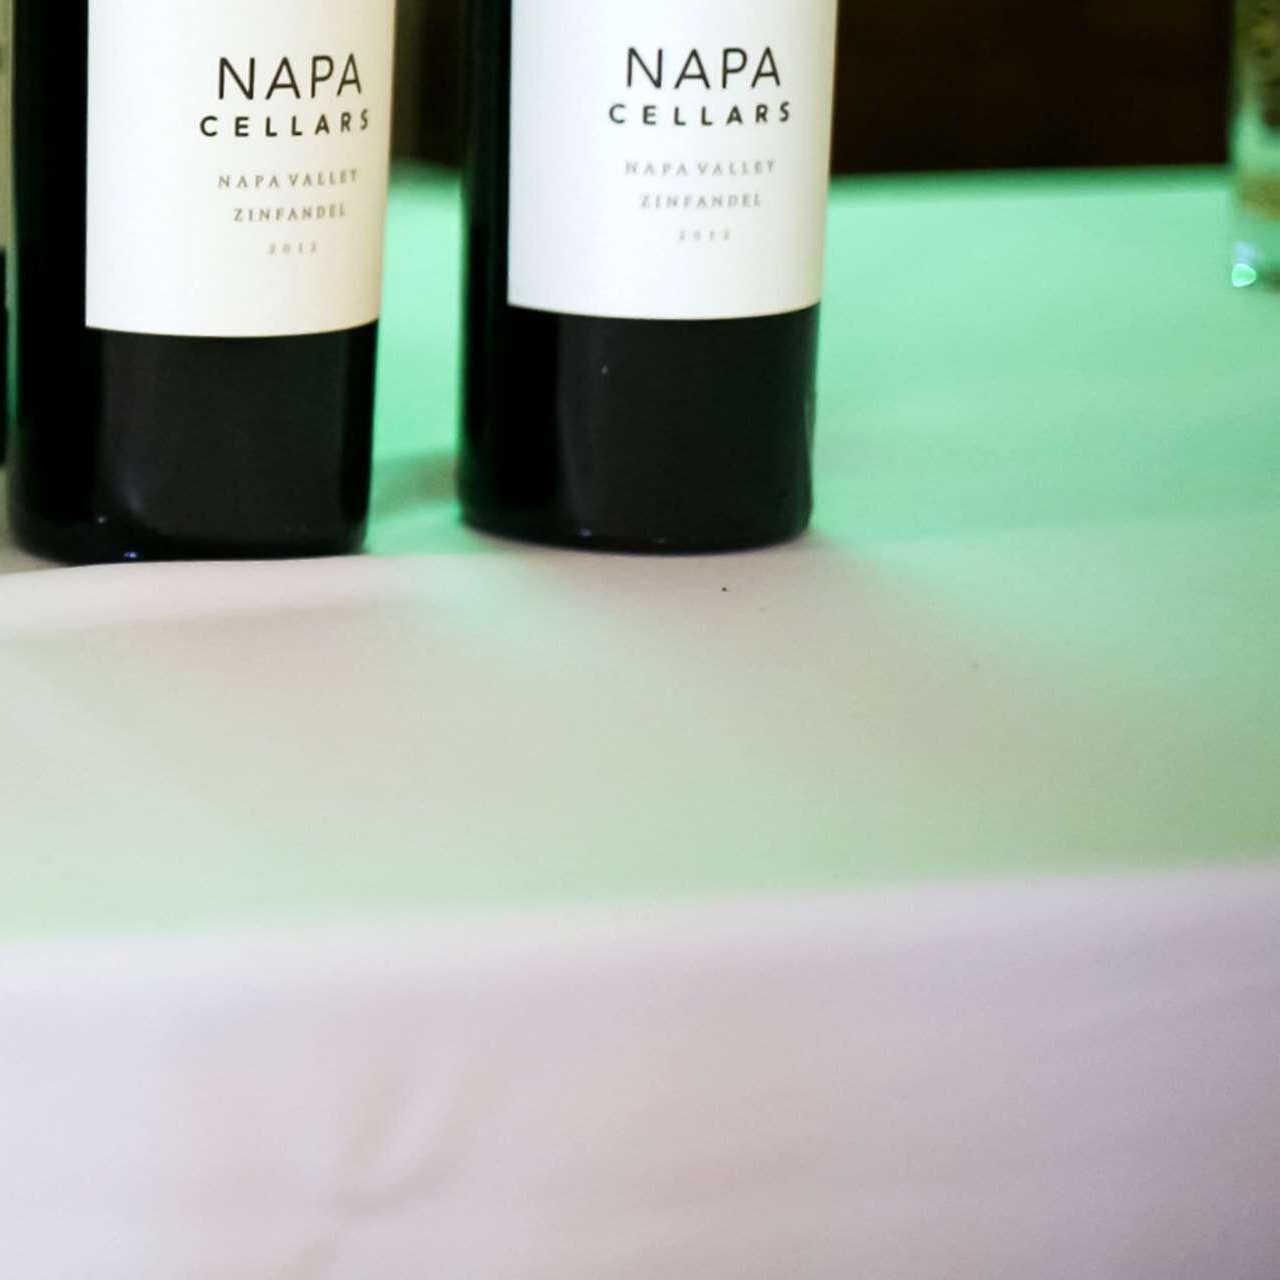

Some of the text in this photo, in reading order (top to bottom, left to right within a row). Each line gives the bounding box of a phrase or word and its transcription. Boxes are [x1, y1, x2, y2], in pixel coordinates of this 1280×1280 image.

[217, 52, 362, 101] NAPA
[626, 45, 781, 90] NAPA
[199, 108, 369, 138] CELLARS
[609, 101, 791, 127] CELLARS
[218, 168, 358, 188] NAPA VALLEY
[624, 161, 688, 176] NAPA
[233, 203, 345, 222] ZINFANDEL
